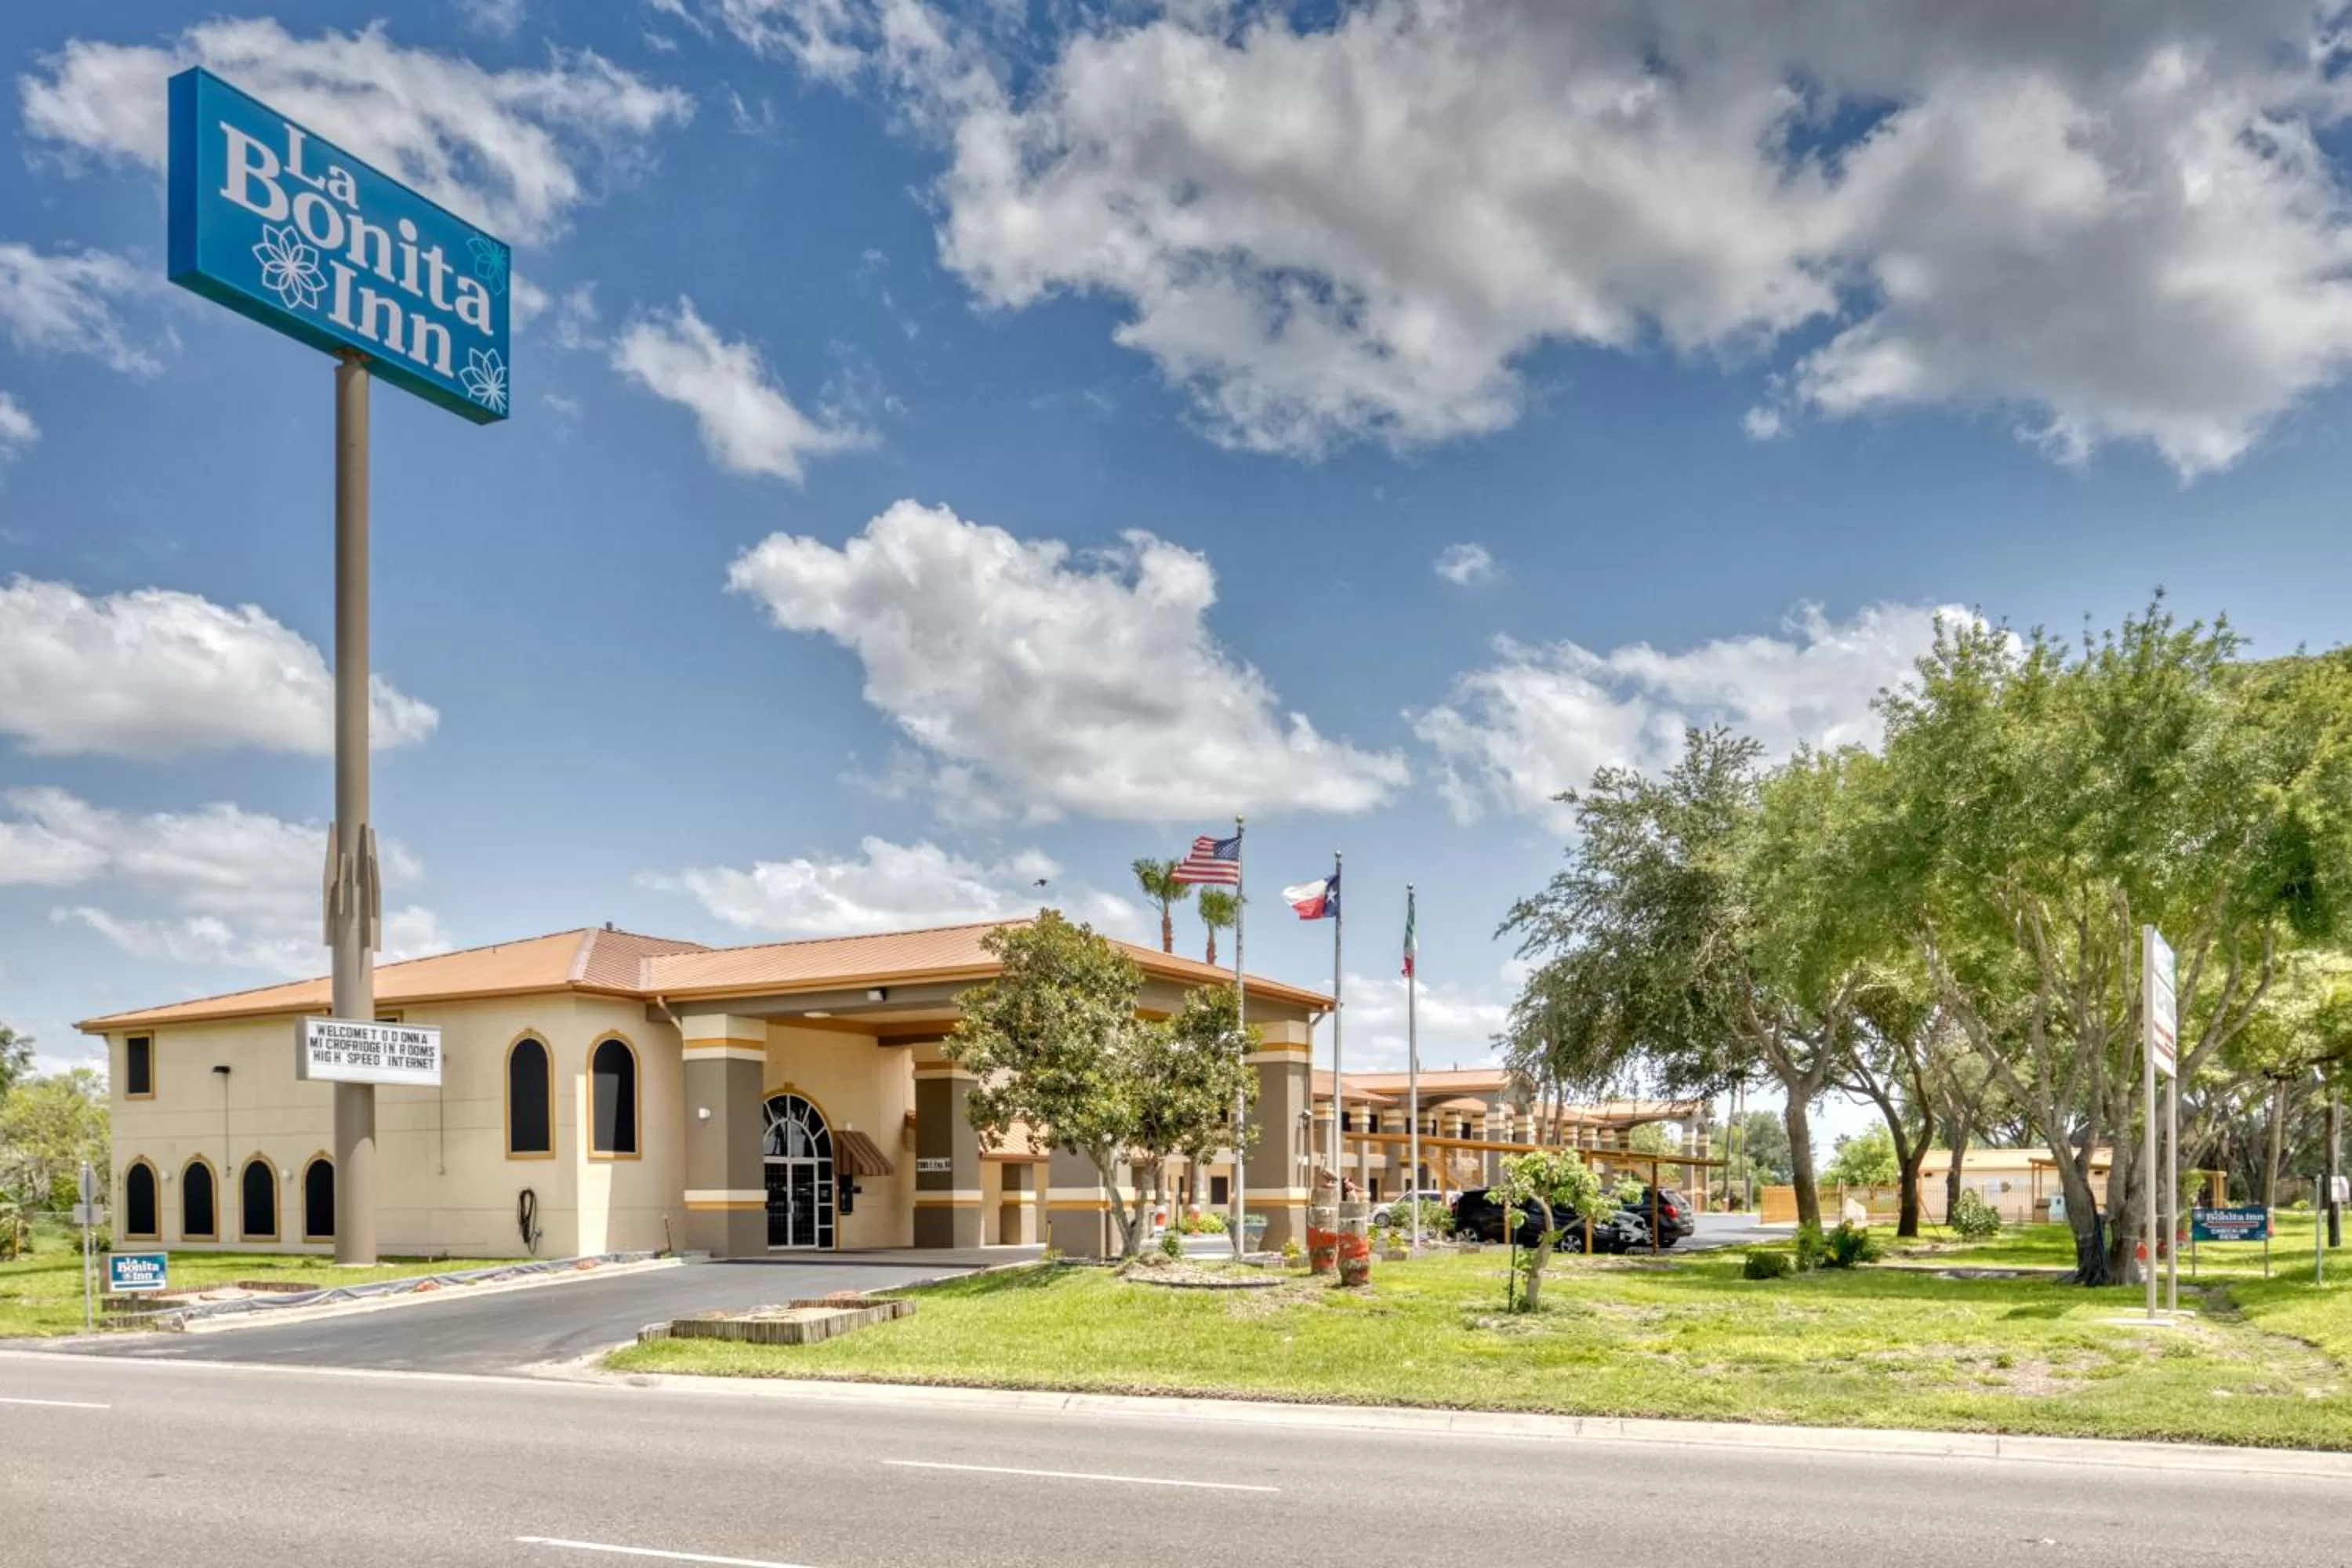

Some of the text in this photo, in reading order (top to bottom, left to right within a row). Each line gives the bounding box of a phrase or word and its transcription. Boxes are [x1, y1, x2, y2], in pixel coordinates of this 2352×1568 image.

[283, 122, 359, 210] La
[219, 120, 494, 336] Bonita
[328, 260, 455, 379] Inn
[316, 1025, 368, 1040] WELCOME
[383, 1042, 395, 1054] IN
[400, 1044, 434, 1057] ROOMS
[313, 1051, 434, 1069] HIGH SPEED INTERNET
[117, 1261, 159, 1272] Bonita
